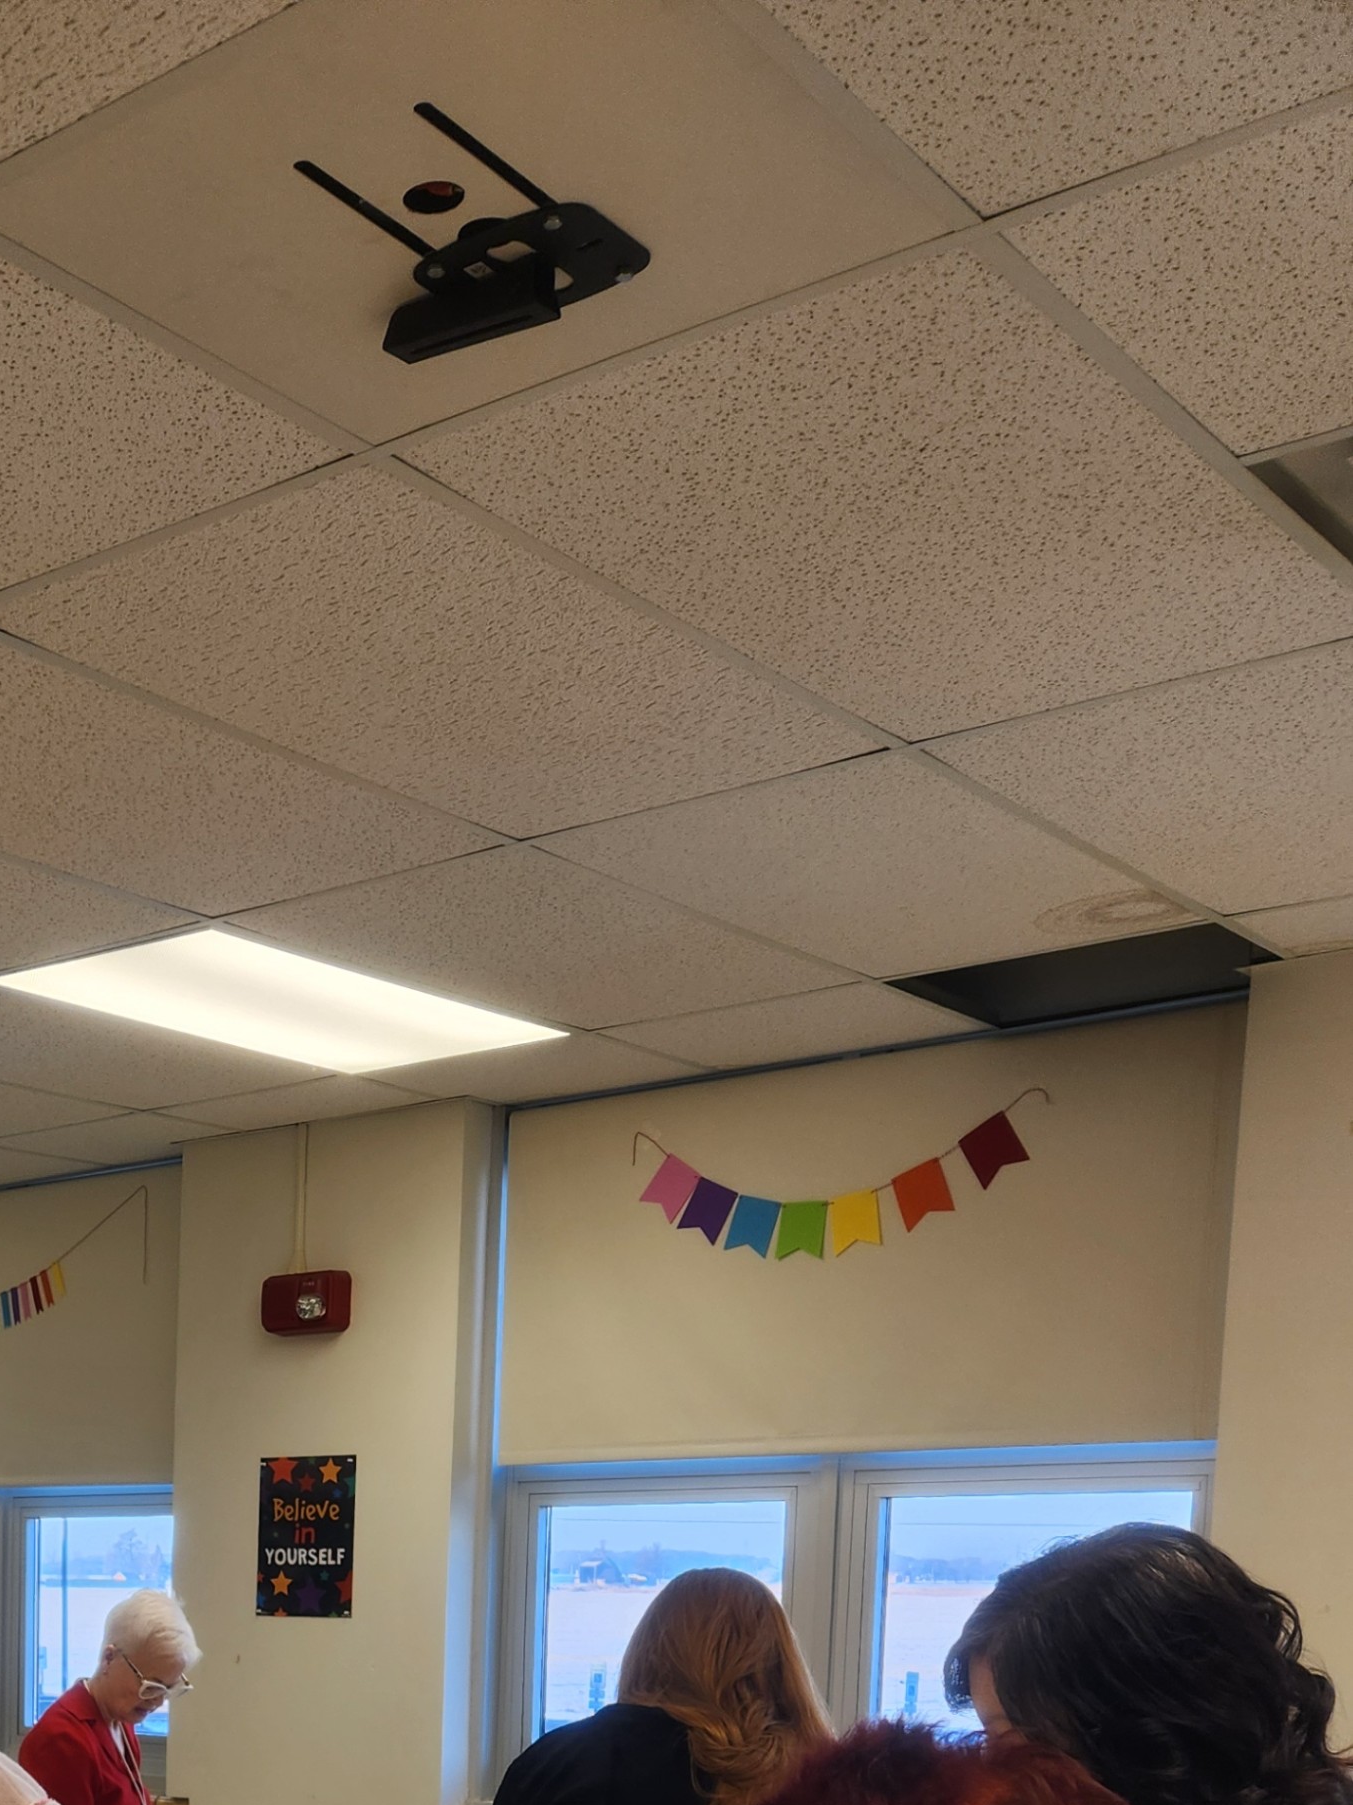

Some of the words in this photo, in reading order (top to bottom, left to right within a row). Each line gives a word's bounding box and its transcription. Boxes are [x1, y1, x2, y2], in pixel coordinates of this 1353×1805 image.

[272, 1497, 340, 1522] Believe
[294, 1523, 316, 1545] in
[264, 1547, 346, 1566] YOURSELF
